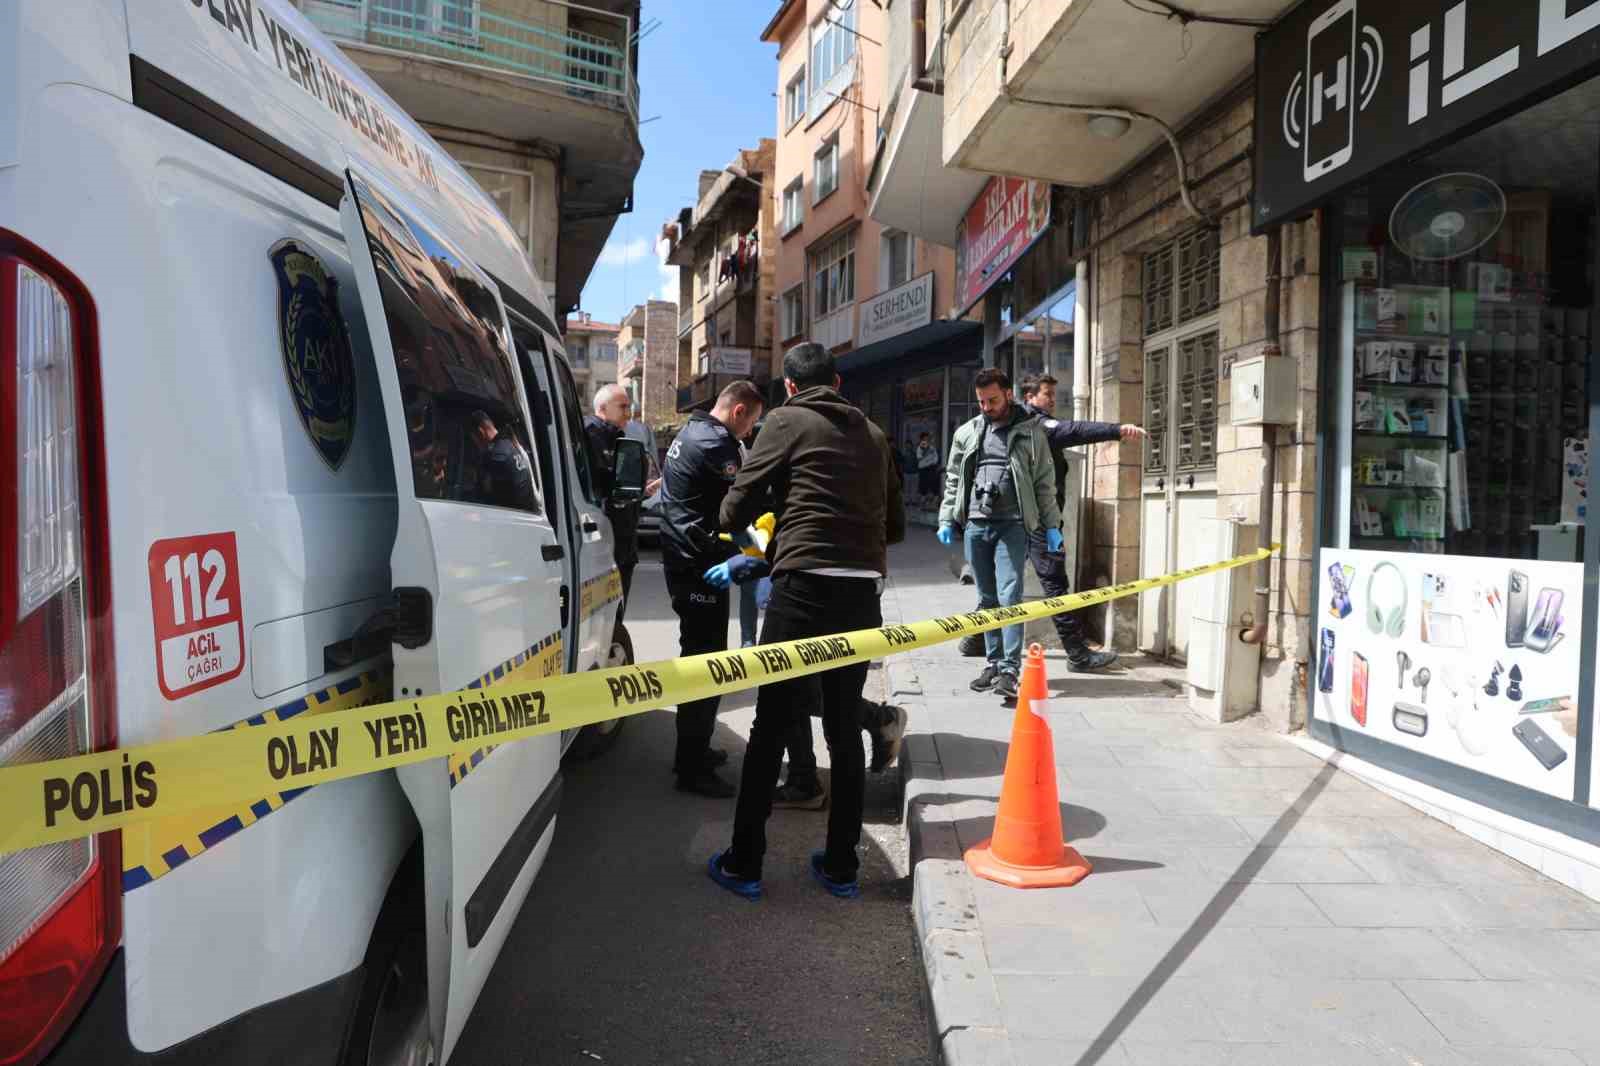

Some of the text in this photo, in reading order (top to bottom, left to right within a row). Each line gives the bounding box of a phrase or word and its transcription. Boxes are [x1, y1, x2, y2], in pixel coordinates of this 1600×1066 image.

[1312, 55, 1347, 125] H
[164, 549, 230, 625] 112
[187, 656, 222, 682] ÇAĞRI
[43, 753, 157, 827] POLİS
[267, 727, 339, 780] OLAY
[364, 703, 428, 758] YERİ
[446, 692, 550, 743] GİRİLMEZ
[606, 666, 663, 707] POLİS
[707, 655, 747, 685] OLAY
